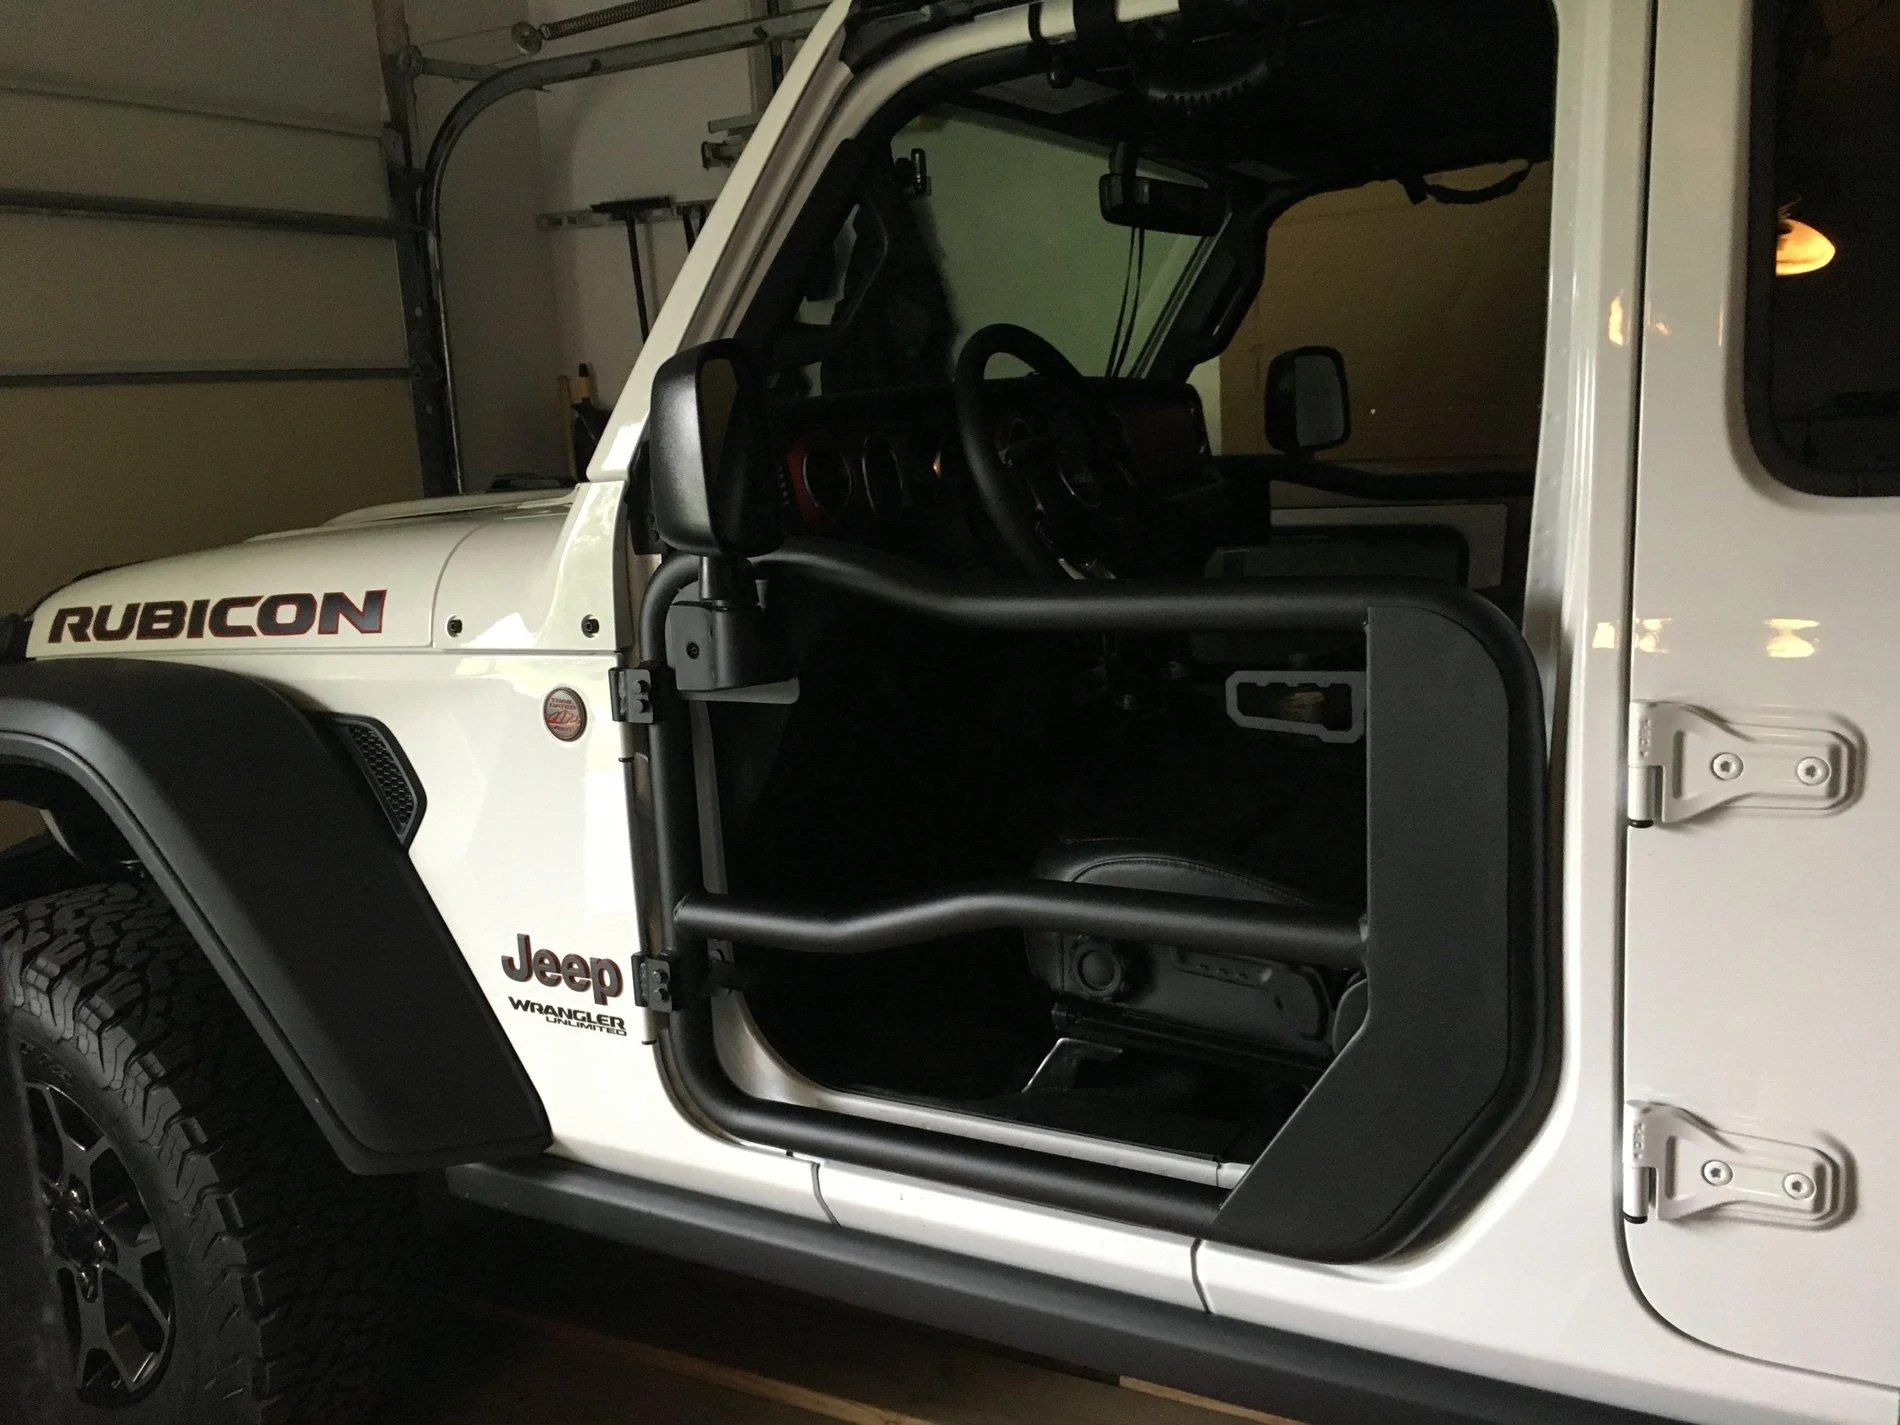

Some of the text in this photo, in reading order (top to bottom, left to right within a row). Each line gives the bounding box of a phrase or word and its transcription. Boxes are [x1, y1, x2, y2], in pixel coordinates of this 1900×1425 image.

[48, 590, 387, 643] RUBICON
[501, 933, 624, 1006] Jeep
[508, 996, 626, 1030] WRANGLER
[546, 1016, 627, 1036] UNLIMITED
